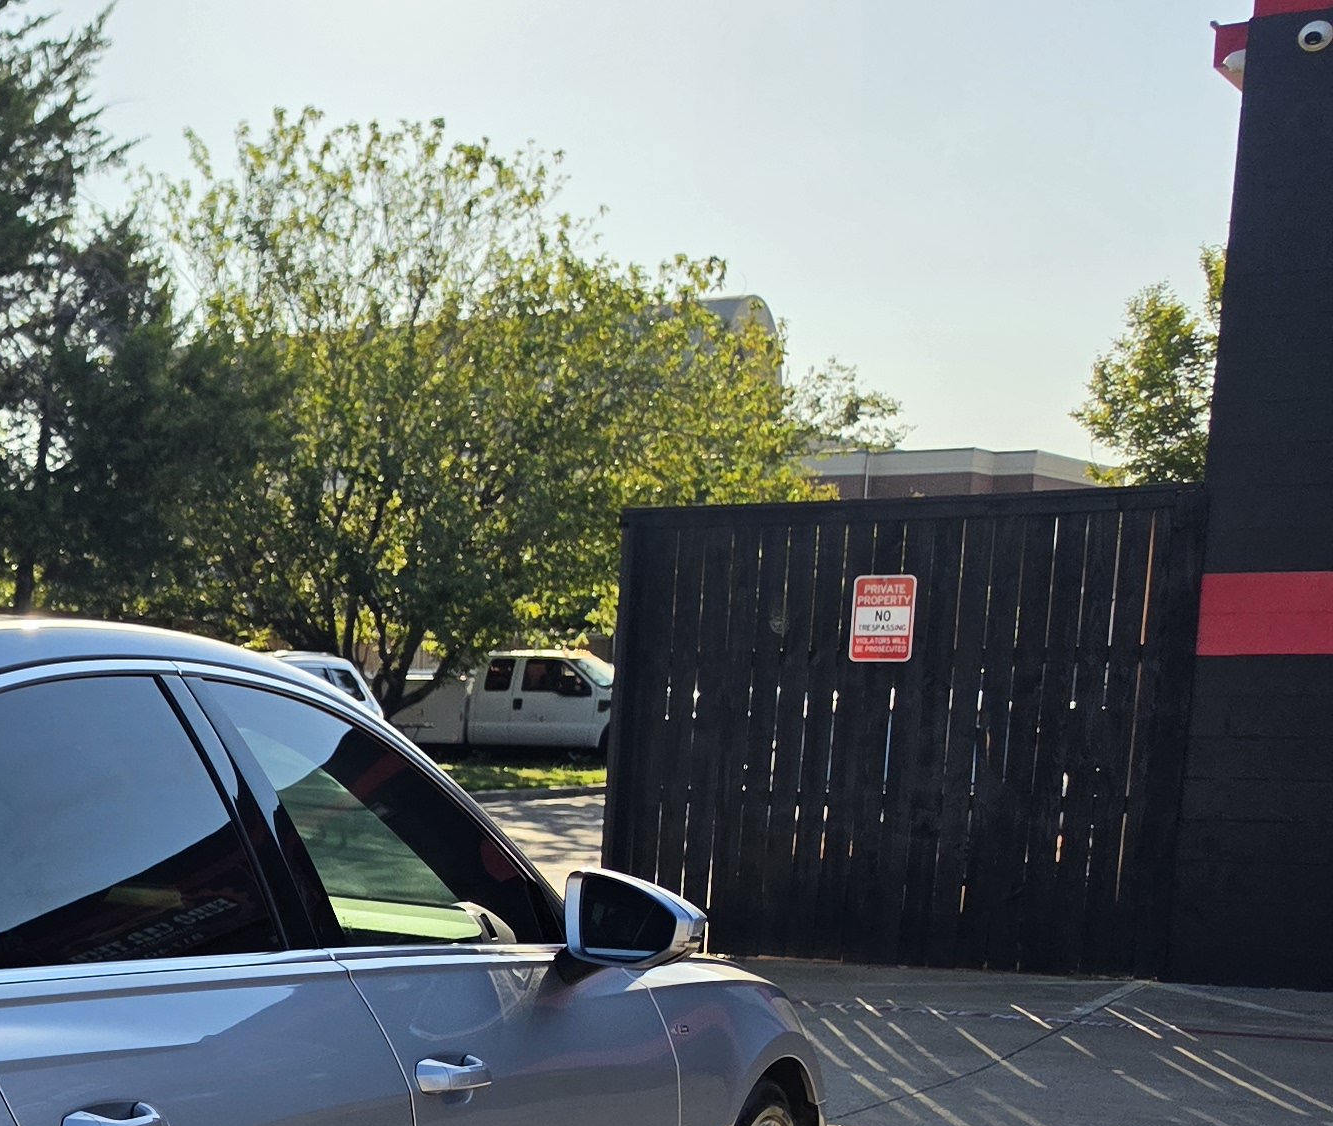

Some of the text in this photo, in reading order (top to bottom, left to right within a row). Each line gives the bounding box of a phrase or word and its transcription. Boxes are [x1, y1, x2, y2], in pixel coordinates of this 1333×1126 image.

[864, 584, 907, 594] PRIVATE
[857, 595, 911, 605] PROPERTY
[875, 610, 891, 622] NO
[859, 624, 907, 632] TRESPASSING
[855, 637, 907, 645] VIOLATORS WILL
[865, 645, 907, 653] PROSECUTED
